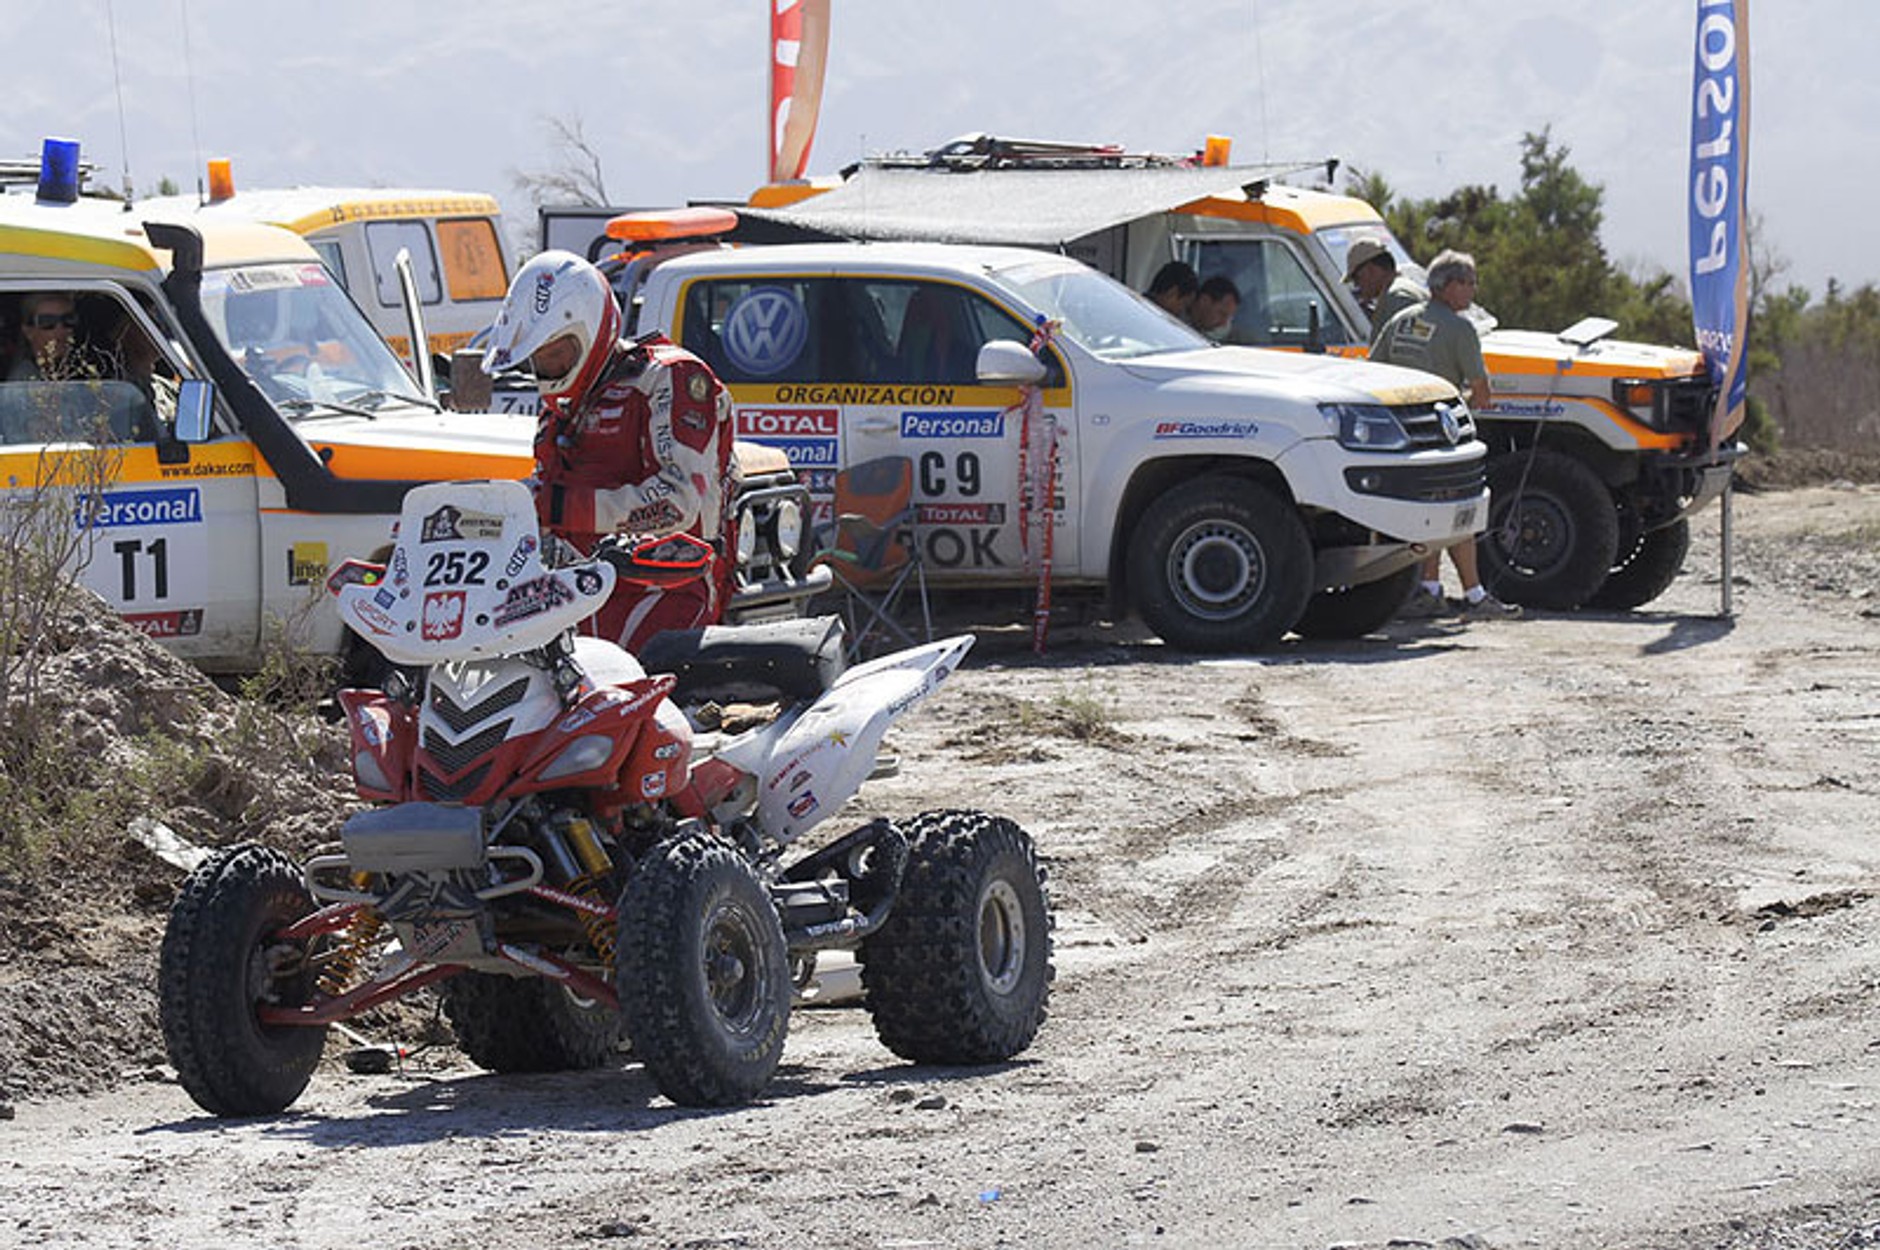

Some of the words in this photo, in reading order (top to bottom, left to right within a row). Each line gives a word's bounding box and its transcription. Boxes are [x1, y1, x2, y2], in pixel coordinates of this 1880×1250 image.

[775, 386, 955, 407] ORGANIZACIÓN
[740, 411, 835, 433] TOTAL
[904, 415, 1001, 436] Personal
[1155, 423, 1260, 436] BFGoodrich
[924, 507, 984, 521] TOTAL
[113, 538, 168, 601] T1
[423, 551, 490, 587] 252
